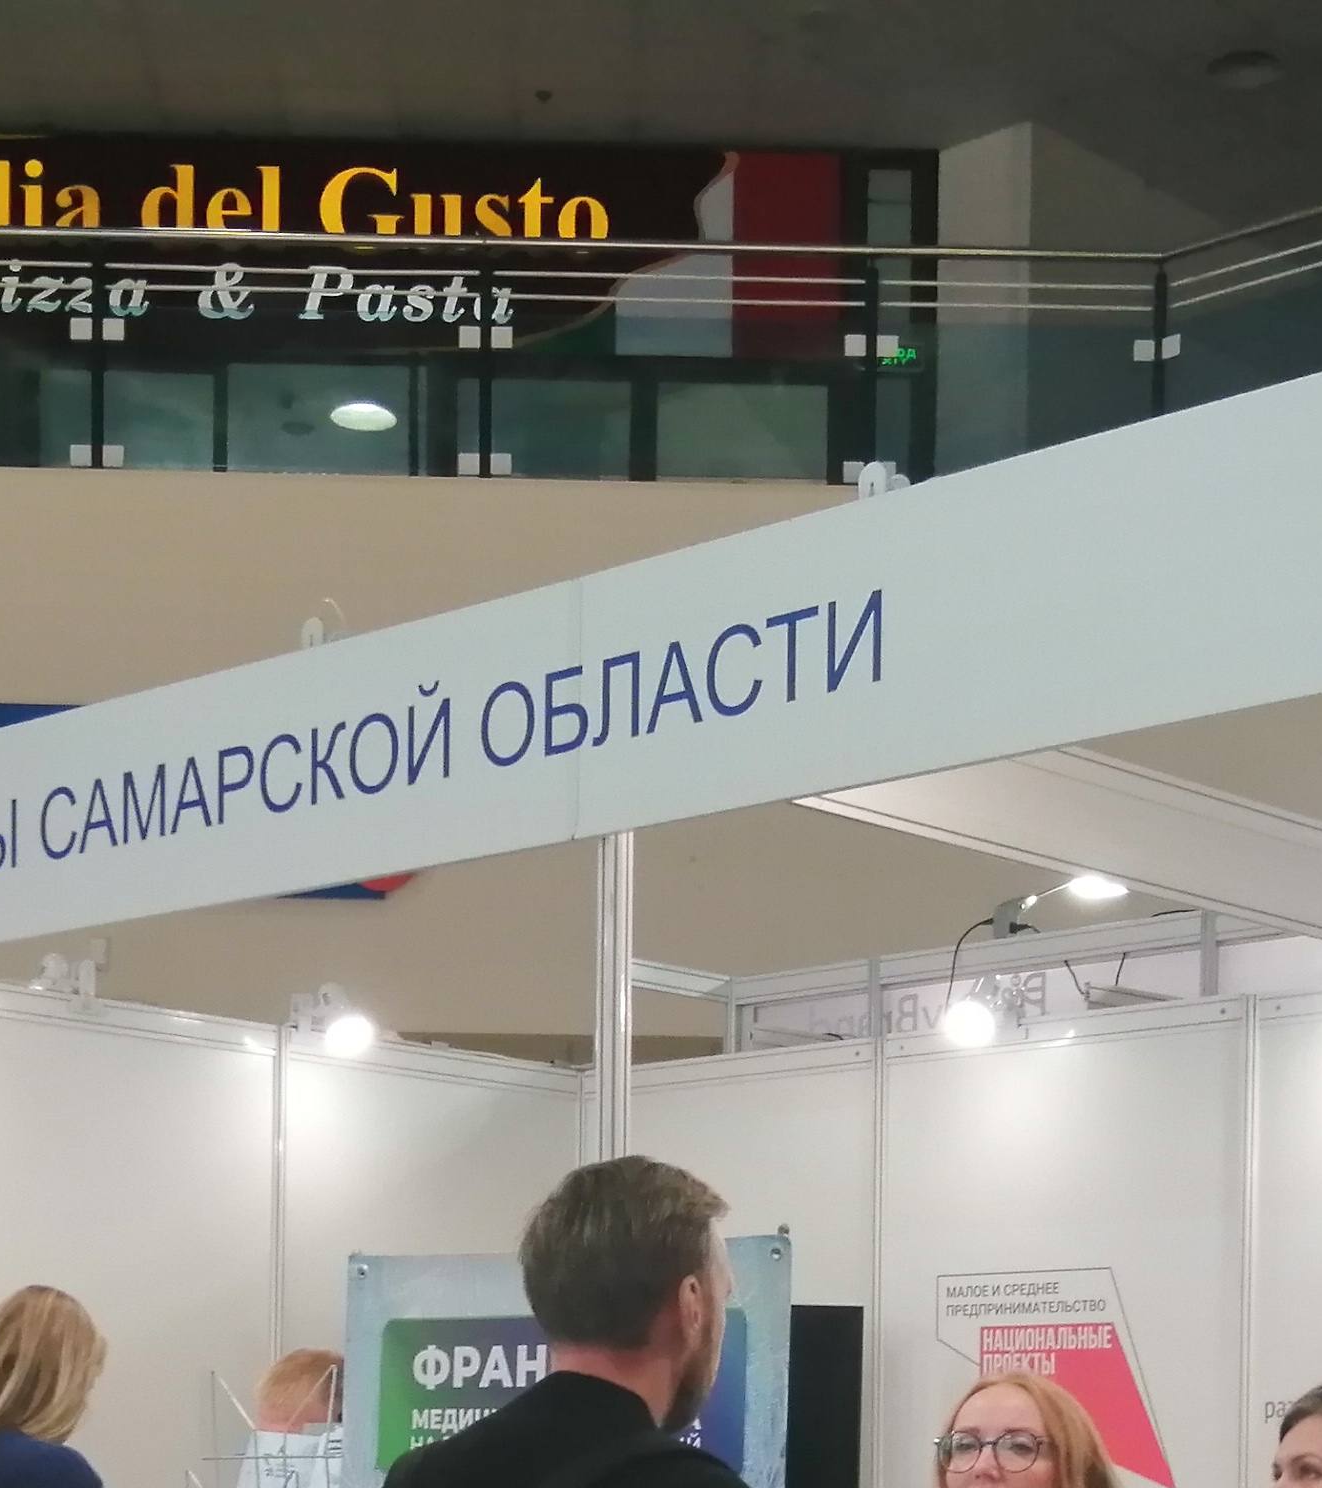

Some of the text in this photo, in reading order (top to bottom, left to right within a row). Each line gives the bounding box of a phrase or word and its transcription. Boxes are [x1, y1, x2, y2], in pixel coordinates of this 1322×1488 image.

[140, 163, 282, 233] del
[319, 165, 611, 241] Gusto
[198, 261, 255, 319] &
[39, 680, 453, 862] САМАРСКОЙ
[480, 589, 885, 769] ОБЛАСТИ
[945, 1299, 1107, 1319] ПРЕДПРИНИМАТЕЛЬСТВО
[946, 1281, 1060, 1299] МАЛОЕ И СРЕДНЕЕ
[982, 1324, 1113, 1352] НАЦИОНАЛЬНЫЕ
